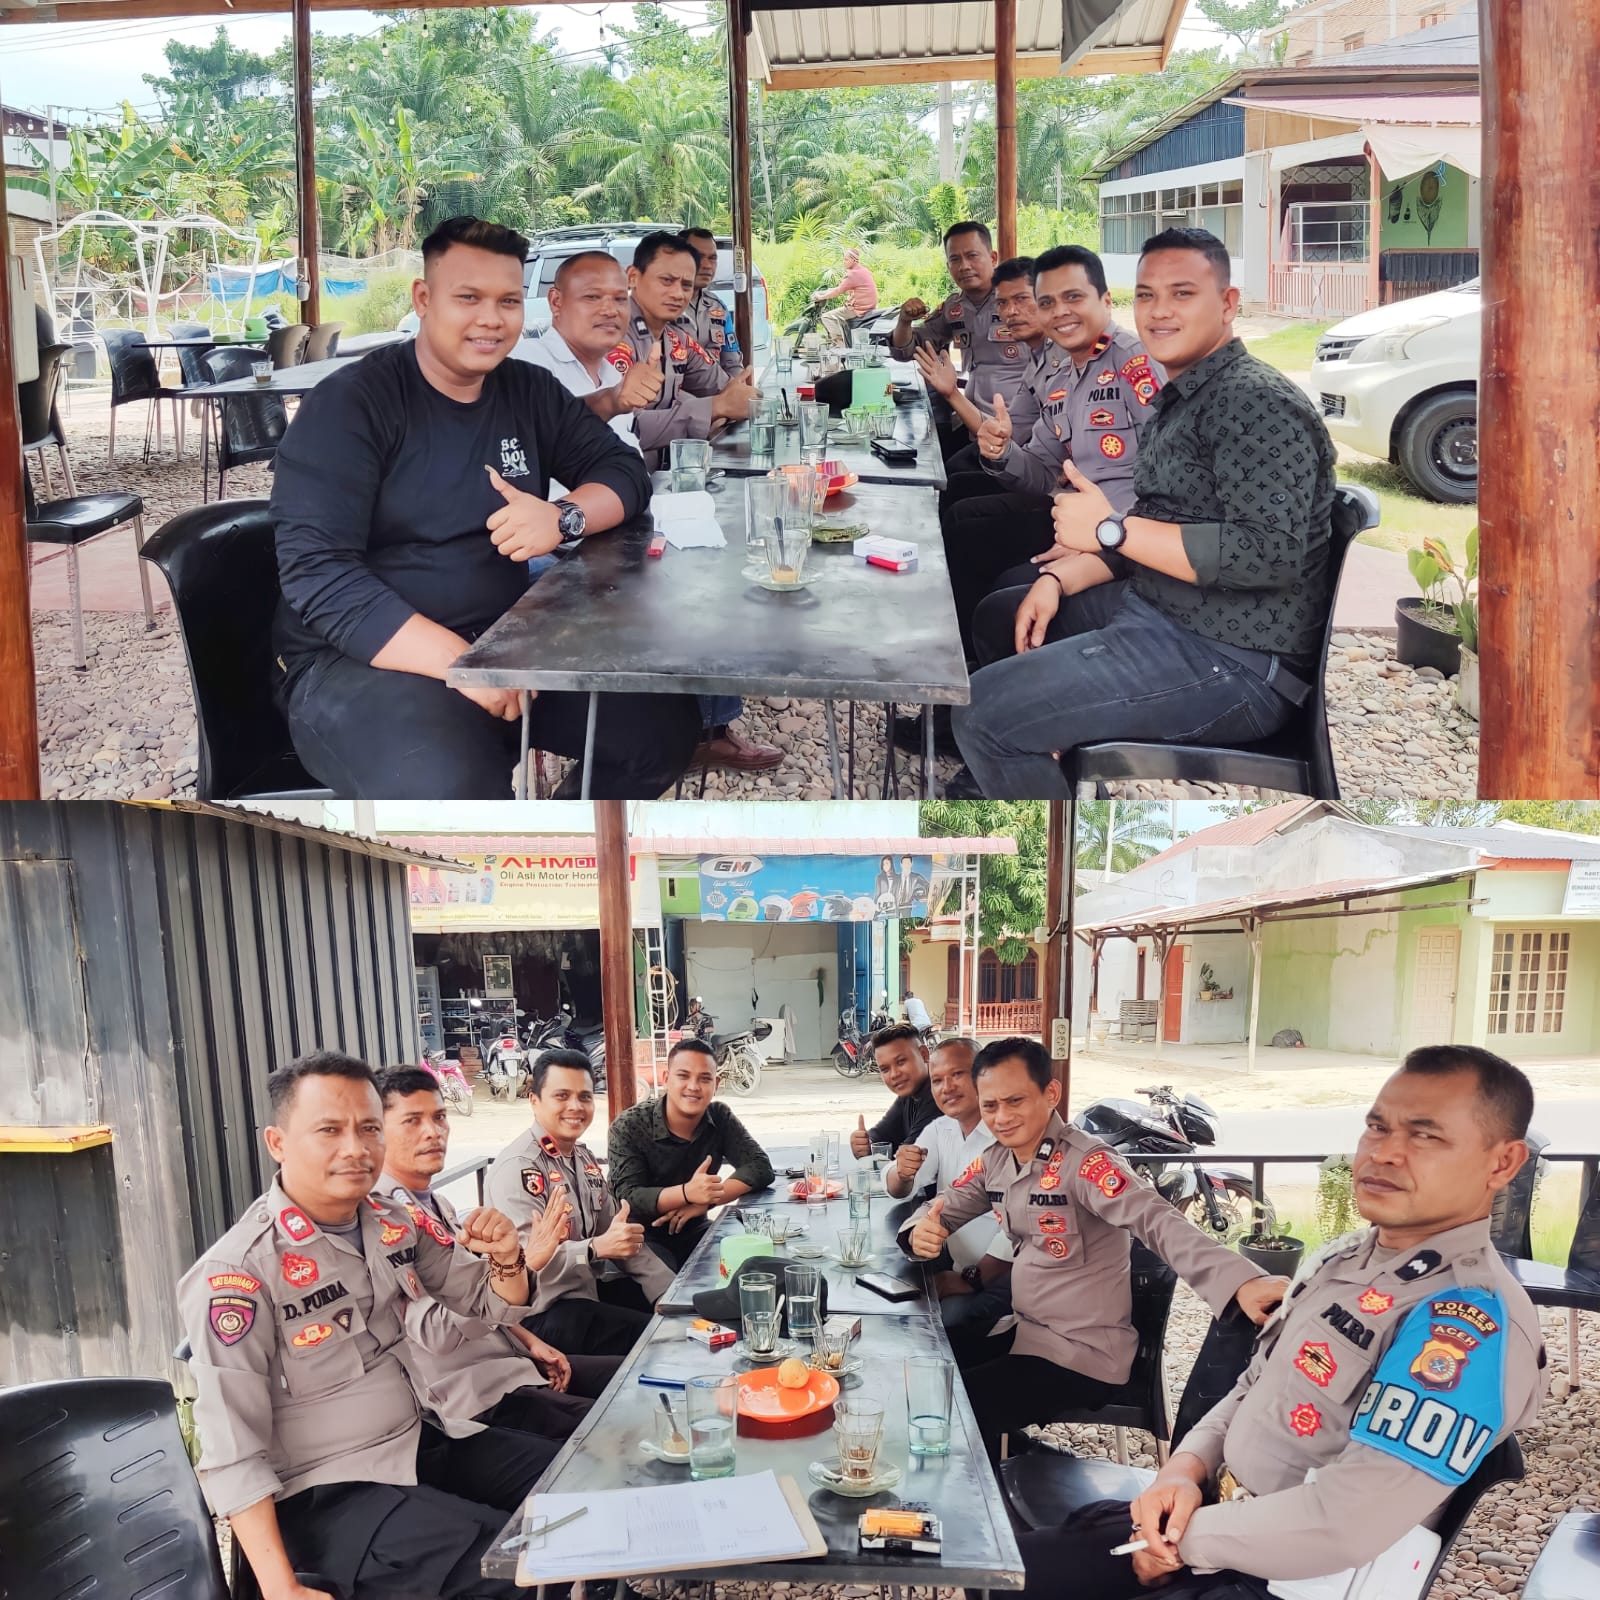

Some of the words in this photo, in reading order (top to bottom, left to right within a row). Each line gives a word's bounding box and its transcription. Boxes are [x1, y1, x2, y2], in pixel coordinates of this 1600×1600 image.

[500, 871, 514, 880] Oli
[517, 871, 536, 880] Asli
[539, 871, 570, 880] Motor
[572, 871, 599, 880] Hond
[713, 861, 752, 872] GM
[282, 1303, 302, 1321] D.
[1434, 1302, 1496, 1331] POLRES
[1320, 1302, 1375, 1350] POLRI
[1435, 1325, 1477, 1346] ACEH
